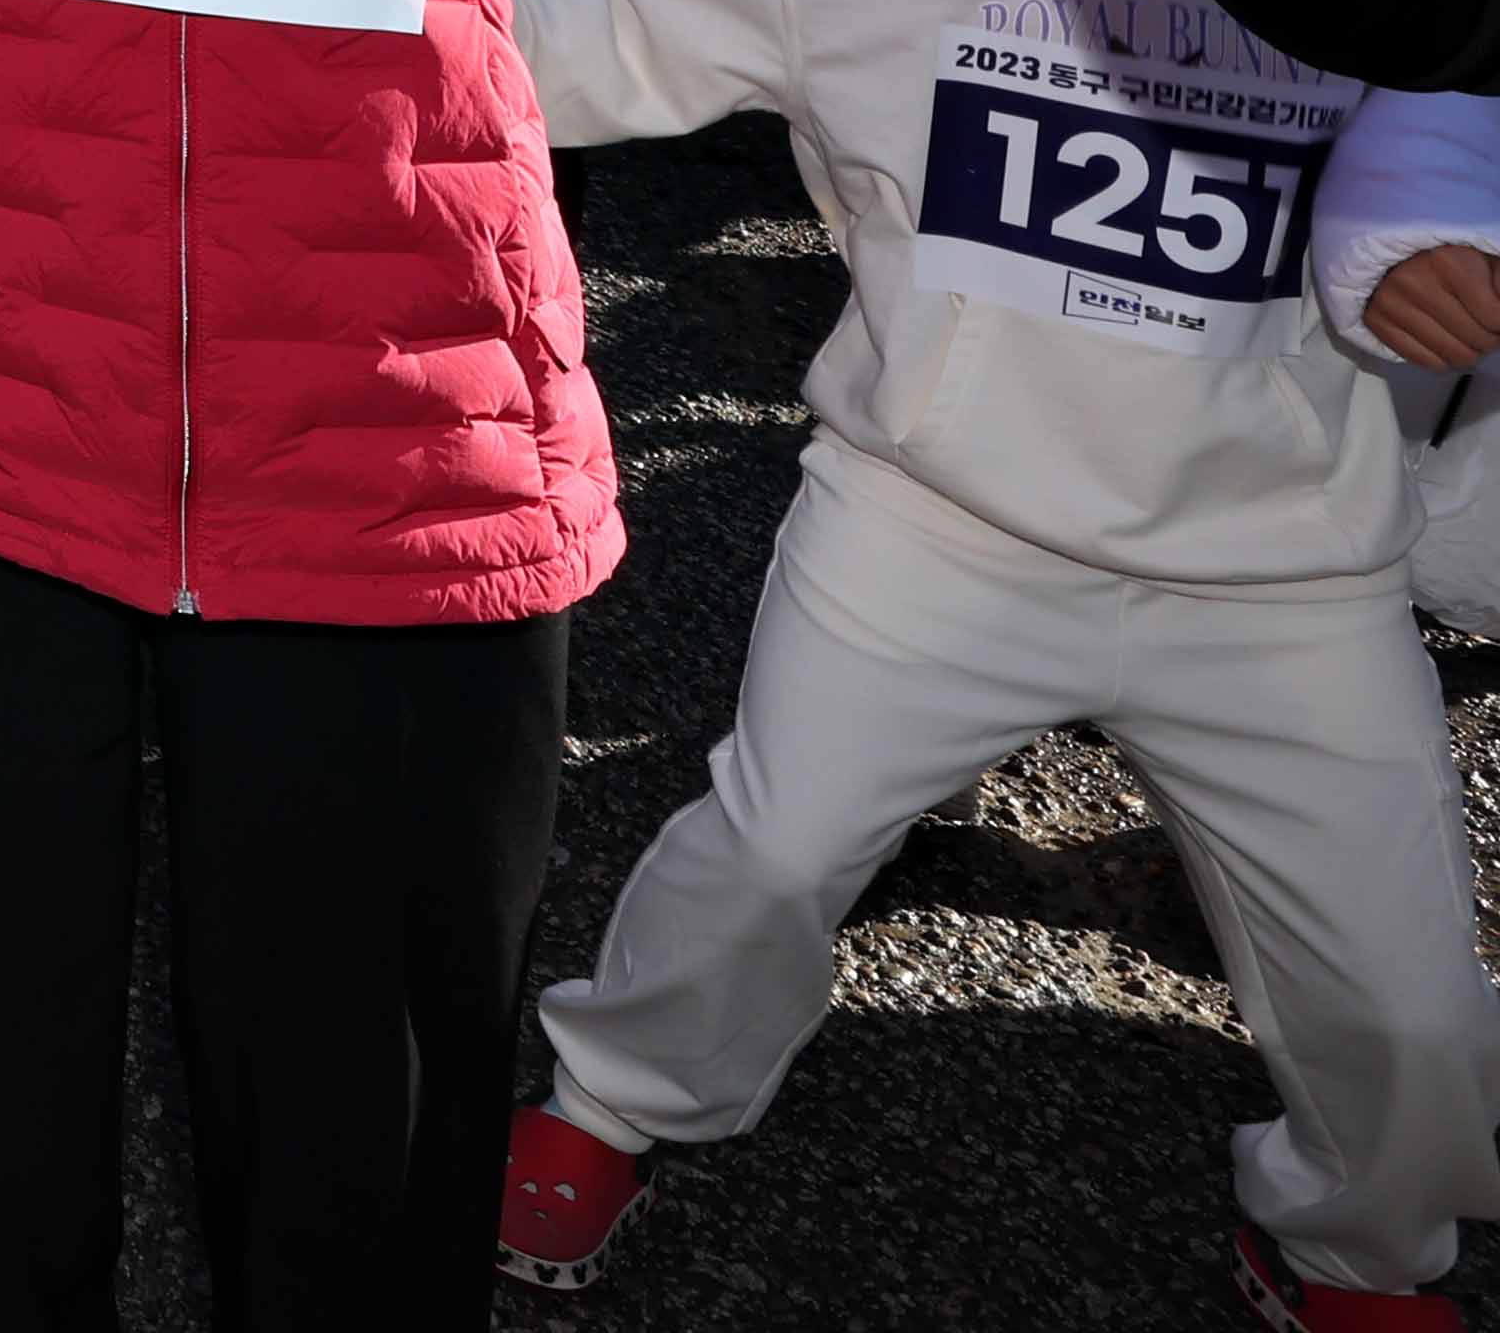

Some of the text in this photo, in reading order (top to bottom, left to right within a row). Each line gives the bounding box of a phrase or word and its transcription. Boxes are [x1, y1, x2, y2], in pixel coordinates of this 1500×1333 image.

[955, 43, 1041, 82] 2023
[1047, 61, 1111, 96] 동구
[1077, 289, 1206, 332] 인천일보
